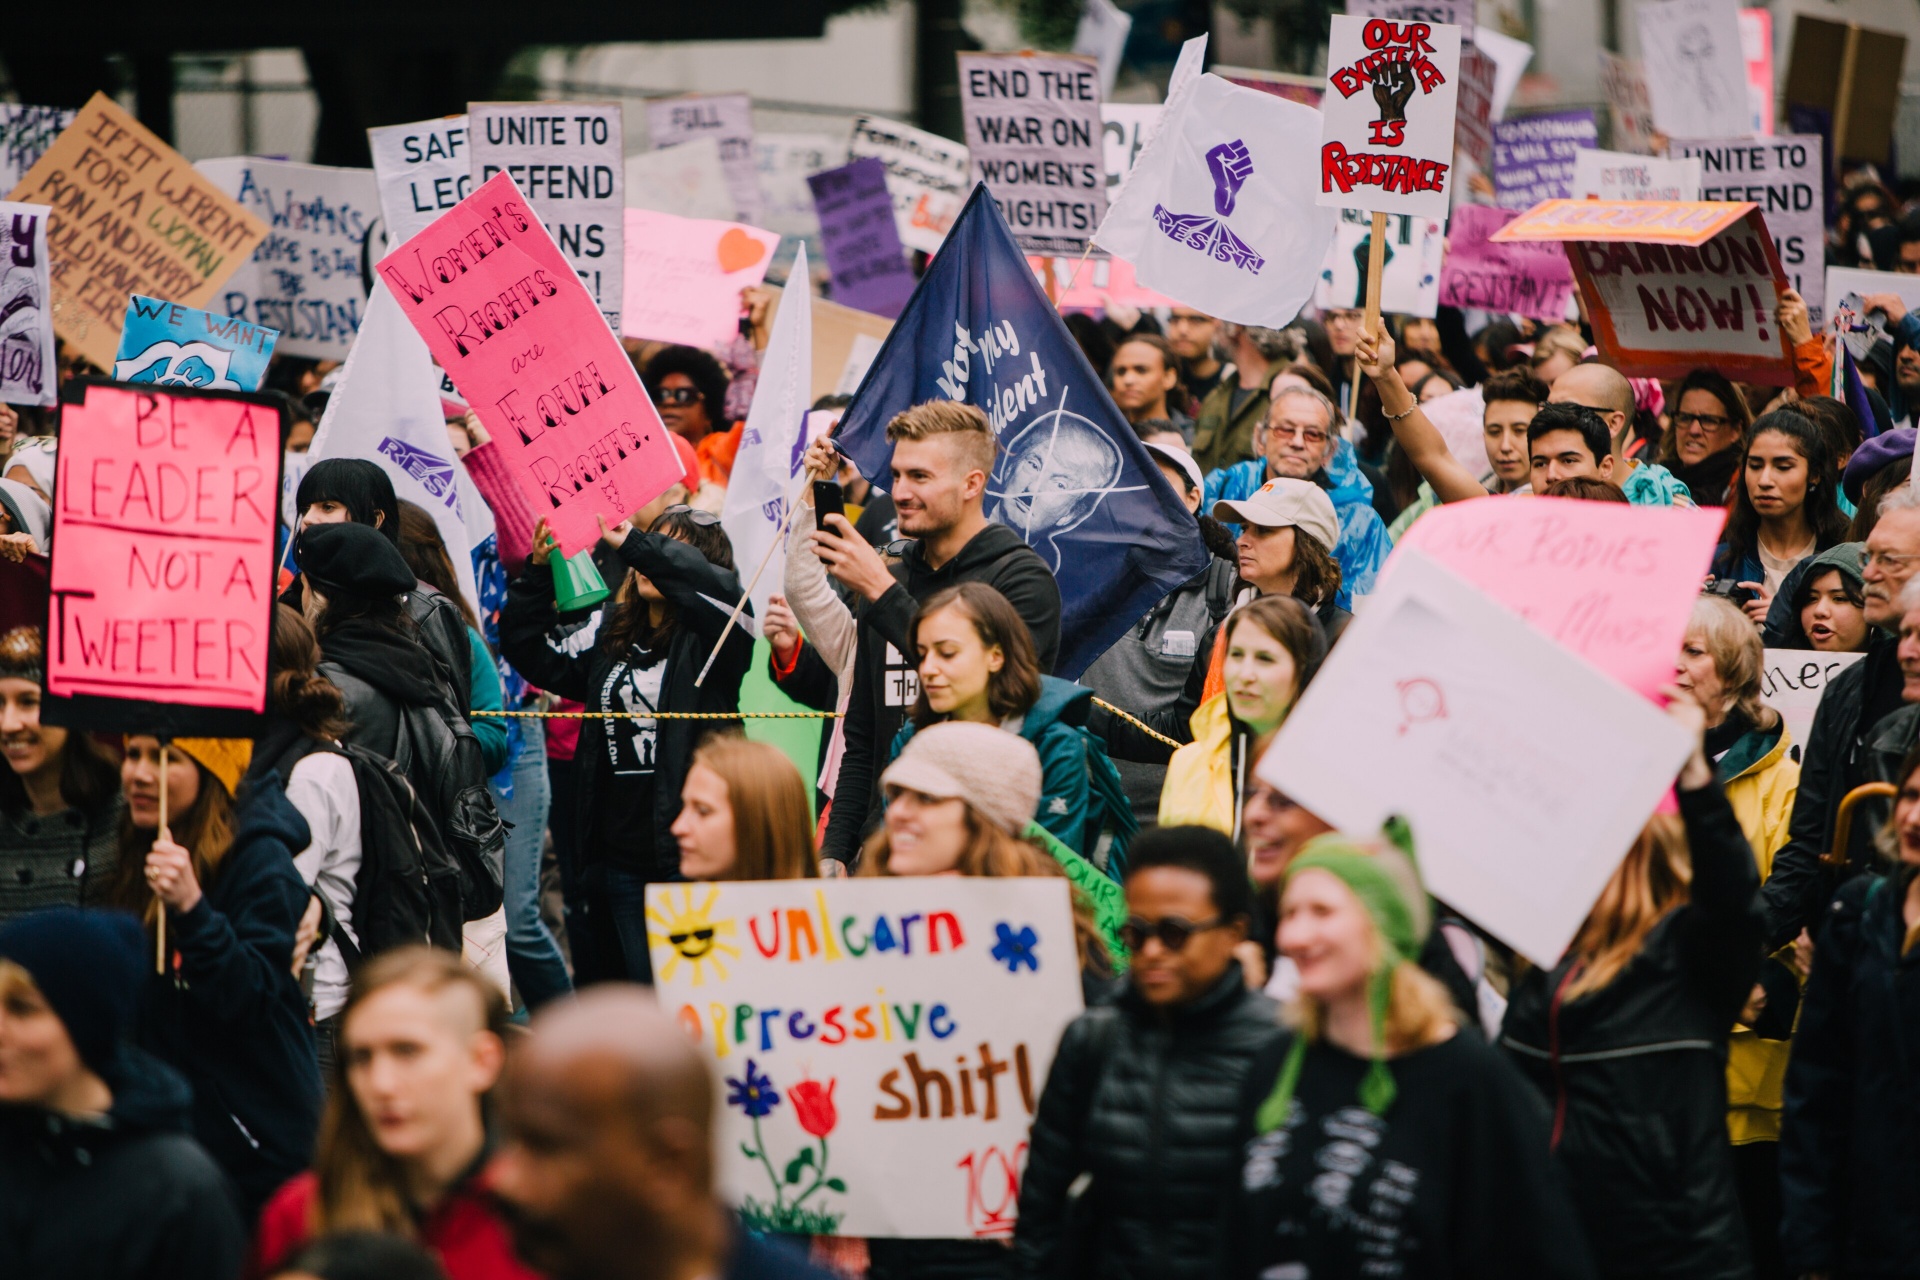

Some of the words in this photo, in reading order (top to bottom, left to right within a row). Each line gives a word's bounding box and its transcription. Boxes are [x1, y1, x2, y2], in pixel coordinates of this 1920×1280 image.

[1362, 18, 1437, 52] OUR
[969, 69, 1029, 98] END
[1038, 71, 1094, 101] THE
[1329, 45, 1446, 100] EXISTENCE
[85, 112, 130, 148] IF
[119, 137, 161, 173] IT
[403, 128, 470, 164] SAF
[486, 116, 566, 146] UNITE
[574, 116, 608, 146] TO
[976, 115, 1043, 145] WAR
[1052, 118, 1092, 148] ON
[1368, 119, 1407, 147] IS
[1772, 145, 1806, 170] TO
[237, 168, 263, 204] A
[1321, 141, 1450, 195] RESISTANCE
[39, 169, 96, 220] RON
[86, 211, 142, 255] AND
[74, 146, 130, 199] FOR
[119, 190, 145, 219] A
[147, 205, 225, 279] WOMAN
[1152, 203, 1266, 276] RESIST!
[386, 200, 530, 306] WOMEN'S
[131, 295, 188, 327] WE
[205, 313, 273, 355] WANT
[432, 268, 559, 359] RIGHTS
[1636, 283, 1770, 342] NOW!
[510, 343, 545, 375] are
[977, 319, 1020, 375] my
[496, 360, 616, 448] EQUAL
[987, 351, 1048, 441] ident
[136, 393, 192, 450] BE
[225, 404, 259, 459] A
[62, 457, 269, 527] LEADER
[529, 421, 650, 510] RIGHTS.
[128, 546, 213, 592] NOT
[223, 557, 257, 601] A
[51, 590, 260, 683] TWEETER
[603, 716, 616, 736] MY
[606, 738, 619, 765] NOT
